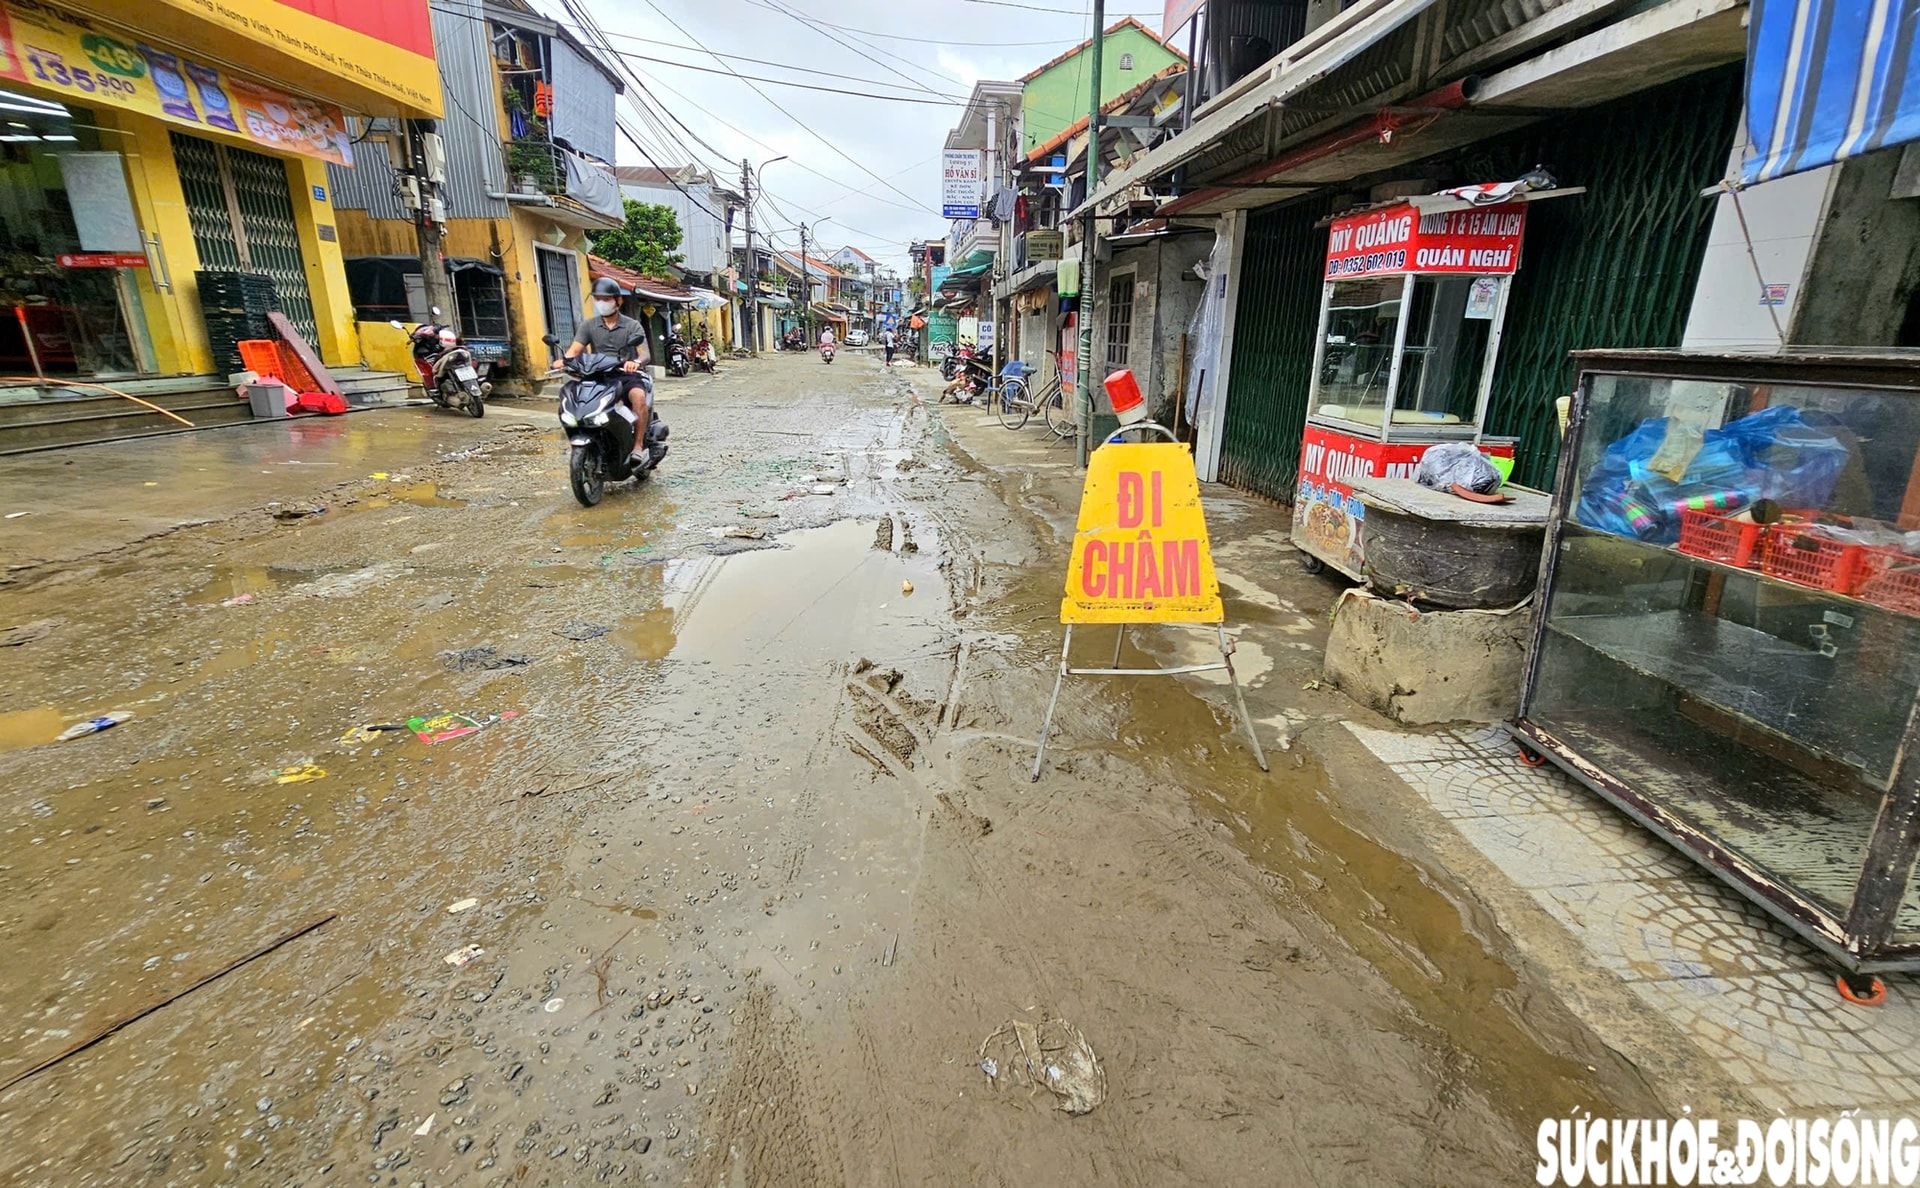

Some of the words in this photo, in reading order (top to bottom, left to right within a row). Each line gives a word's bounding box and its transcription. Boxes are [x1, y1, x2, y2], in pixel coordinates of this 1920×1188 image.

[275, 29, 302, 48] Thành
[955, 166, 970, 179] VĂN
[1354, 211, 1413, 249] QUẢNG
[1449, 214, 1456, 235] 1
[1458, 213, 1466, 235] &
[1469, 213, 1481, 235] 15
[1342, 256, 1365, 274] 0352
[1366, 253, 1384, 271] 602
[1385, 250, 1406, 269] 019
[1415, 244, 1465, 268] QUÁN
[1468, 244, 1514, 268] NGHỈ
[1117, 471, 1163, 529] ĐI
[1082, 529, 1201, 610] CHẬM
